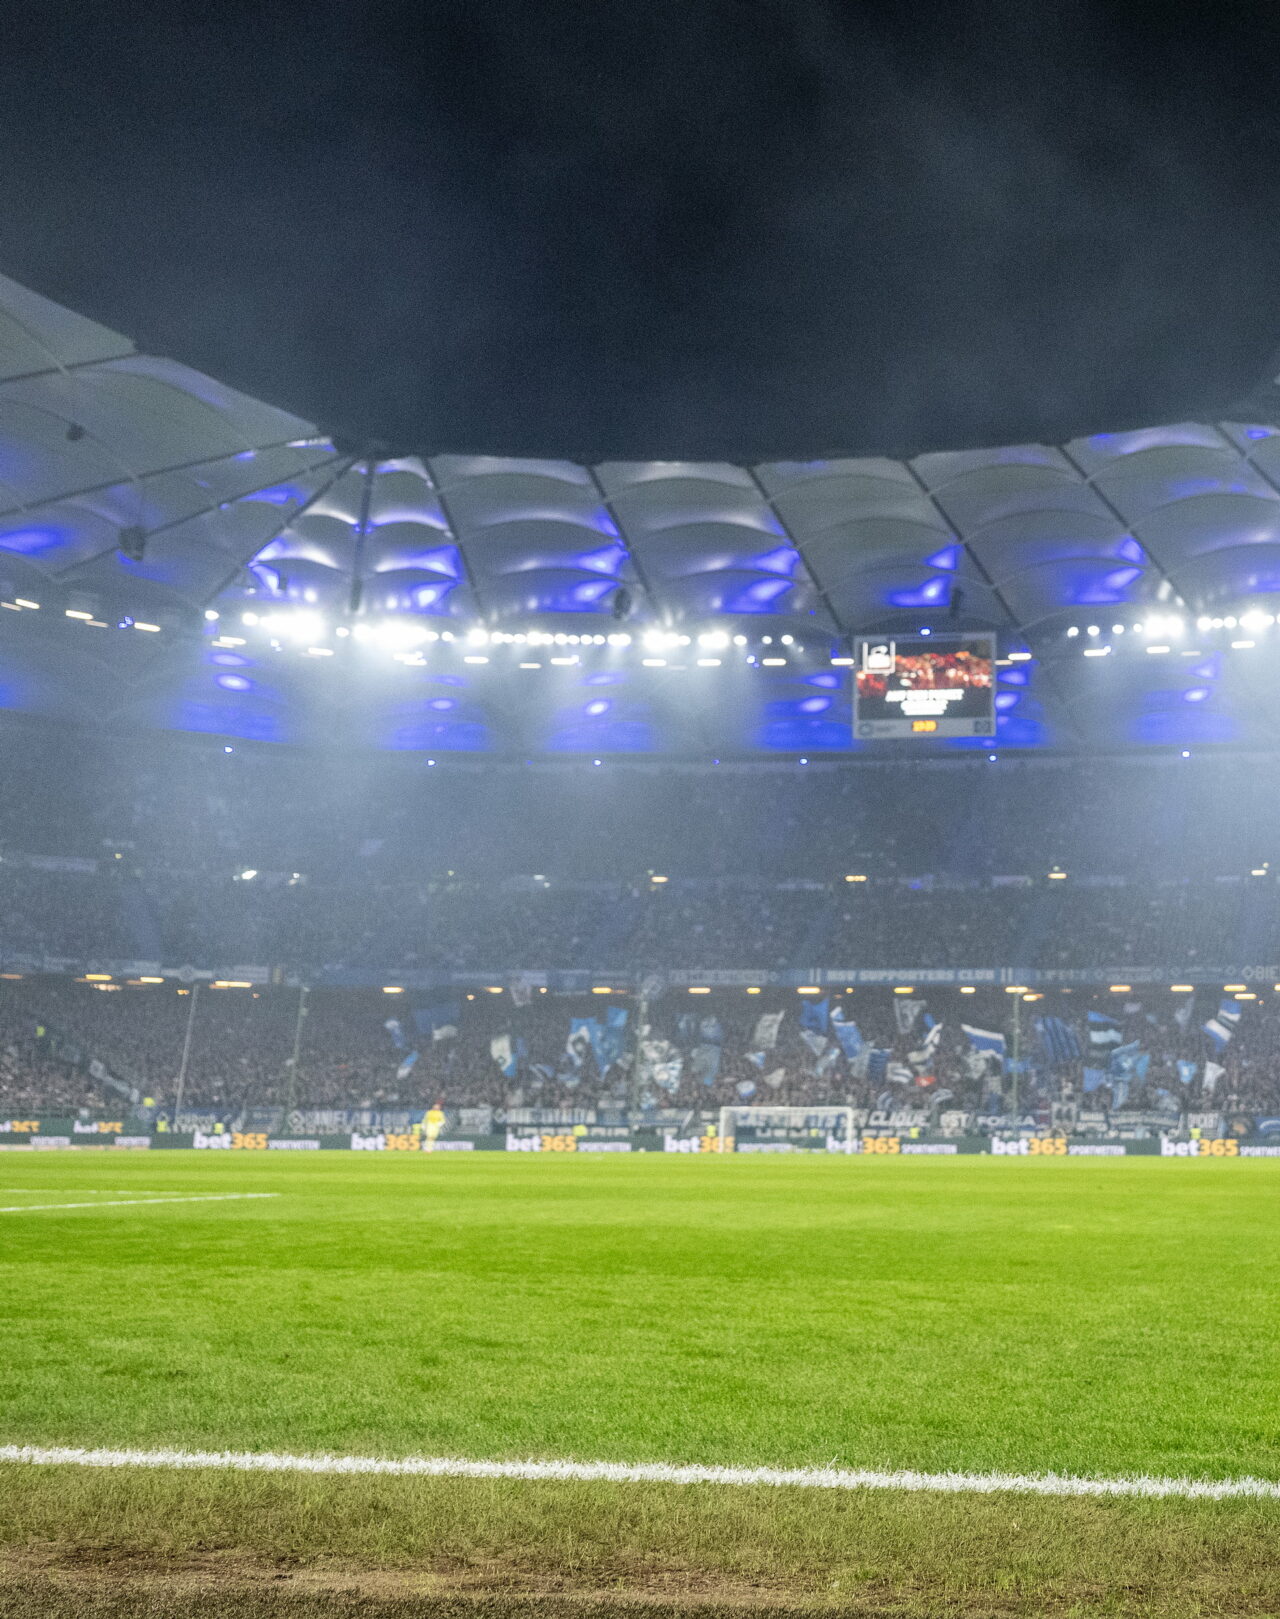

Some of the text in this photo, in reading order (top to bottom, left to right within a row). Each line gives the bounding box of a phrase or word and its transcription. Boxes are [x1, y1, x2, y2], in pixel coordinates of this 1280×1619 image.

[193, 1131, 268, 1150] bet365
[350, 1133, 420, 1151] bet365
[506, 1134, 577, 1152] bet365
[991, 1136, 1067, 1155] bet365
[1160, 1137, 1239, 1156] bet365
